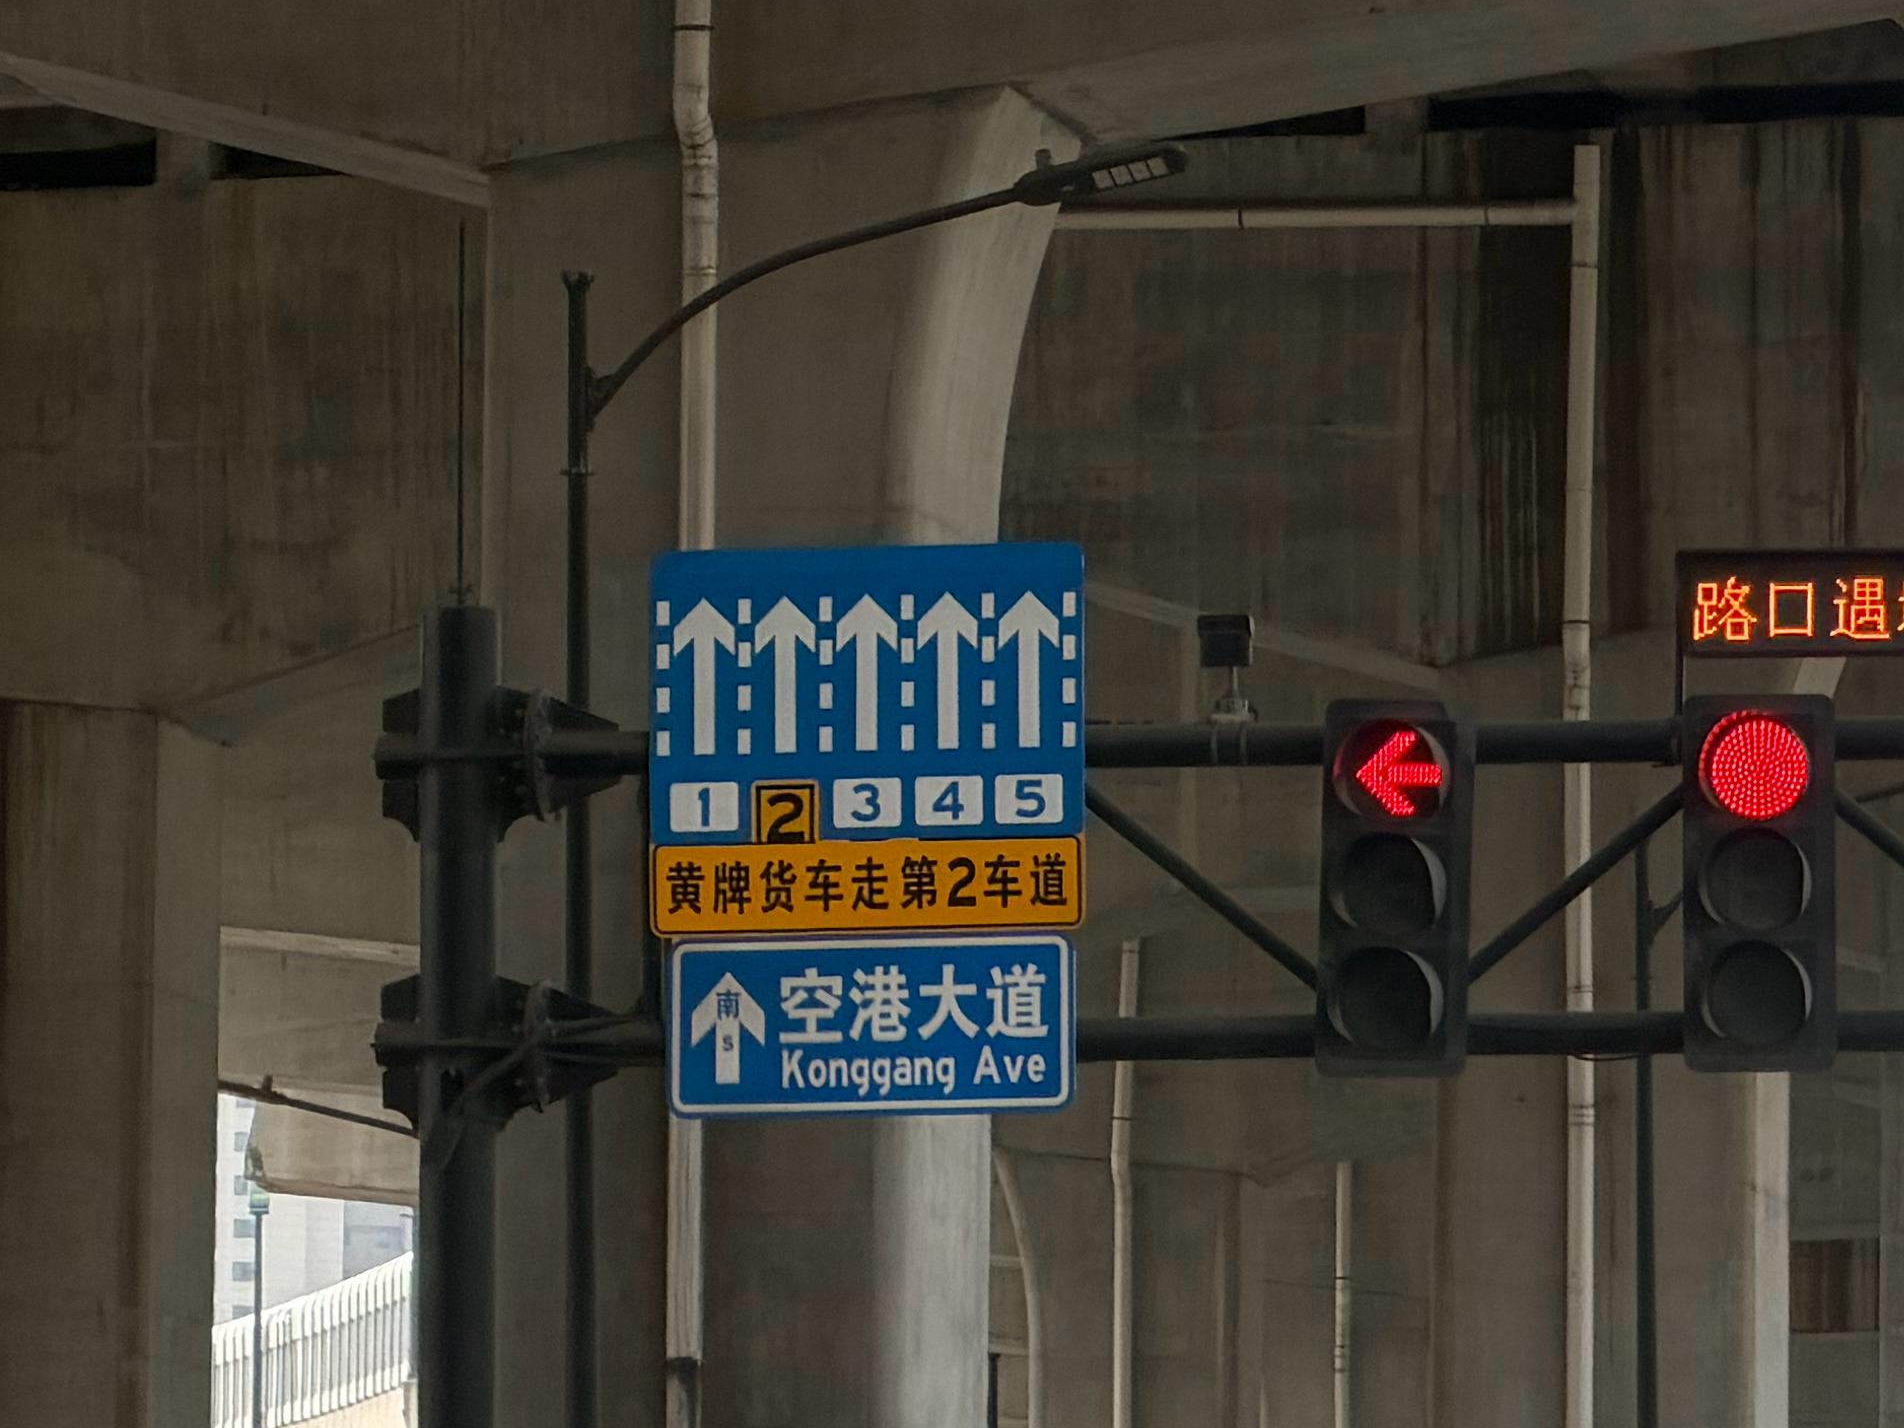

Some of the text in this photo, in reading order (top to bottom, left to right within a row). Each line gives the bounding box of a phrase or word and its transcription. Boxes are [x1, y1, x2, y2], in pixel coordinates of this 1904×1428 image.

[698, 779, 1046, 842] 1 2 3 4 5
[666, 853, 1067, 916] 黄牌货车走第2车道
[716, 988, 741, 1020] 南
[778, 962, 1049, 1044] 空港大道
[722, 1035, 734, 1052] S
[781, 1046, 1046, 1096] Konggang Ave
